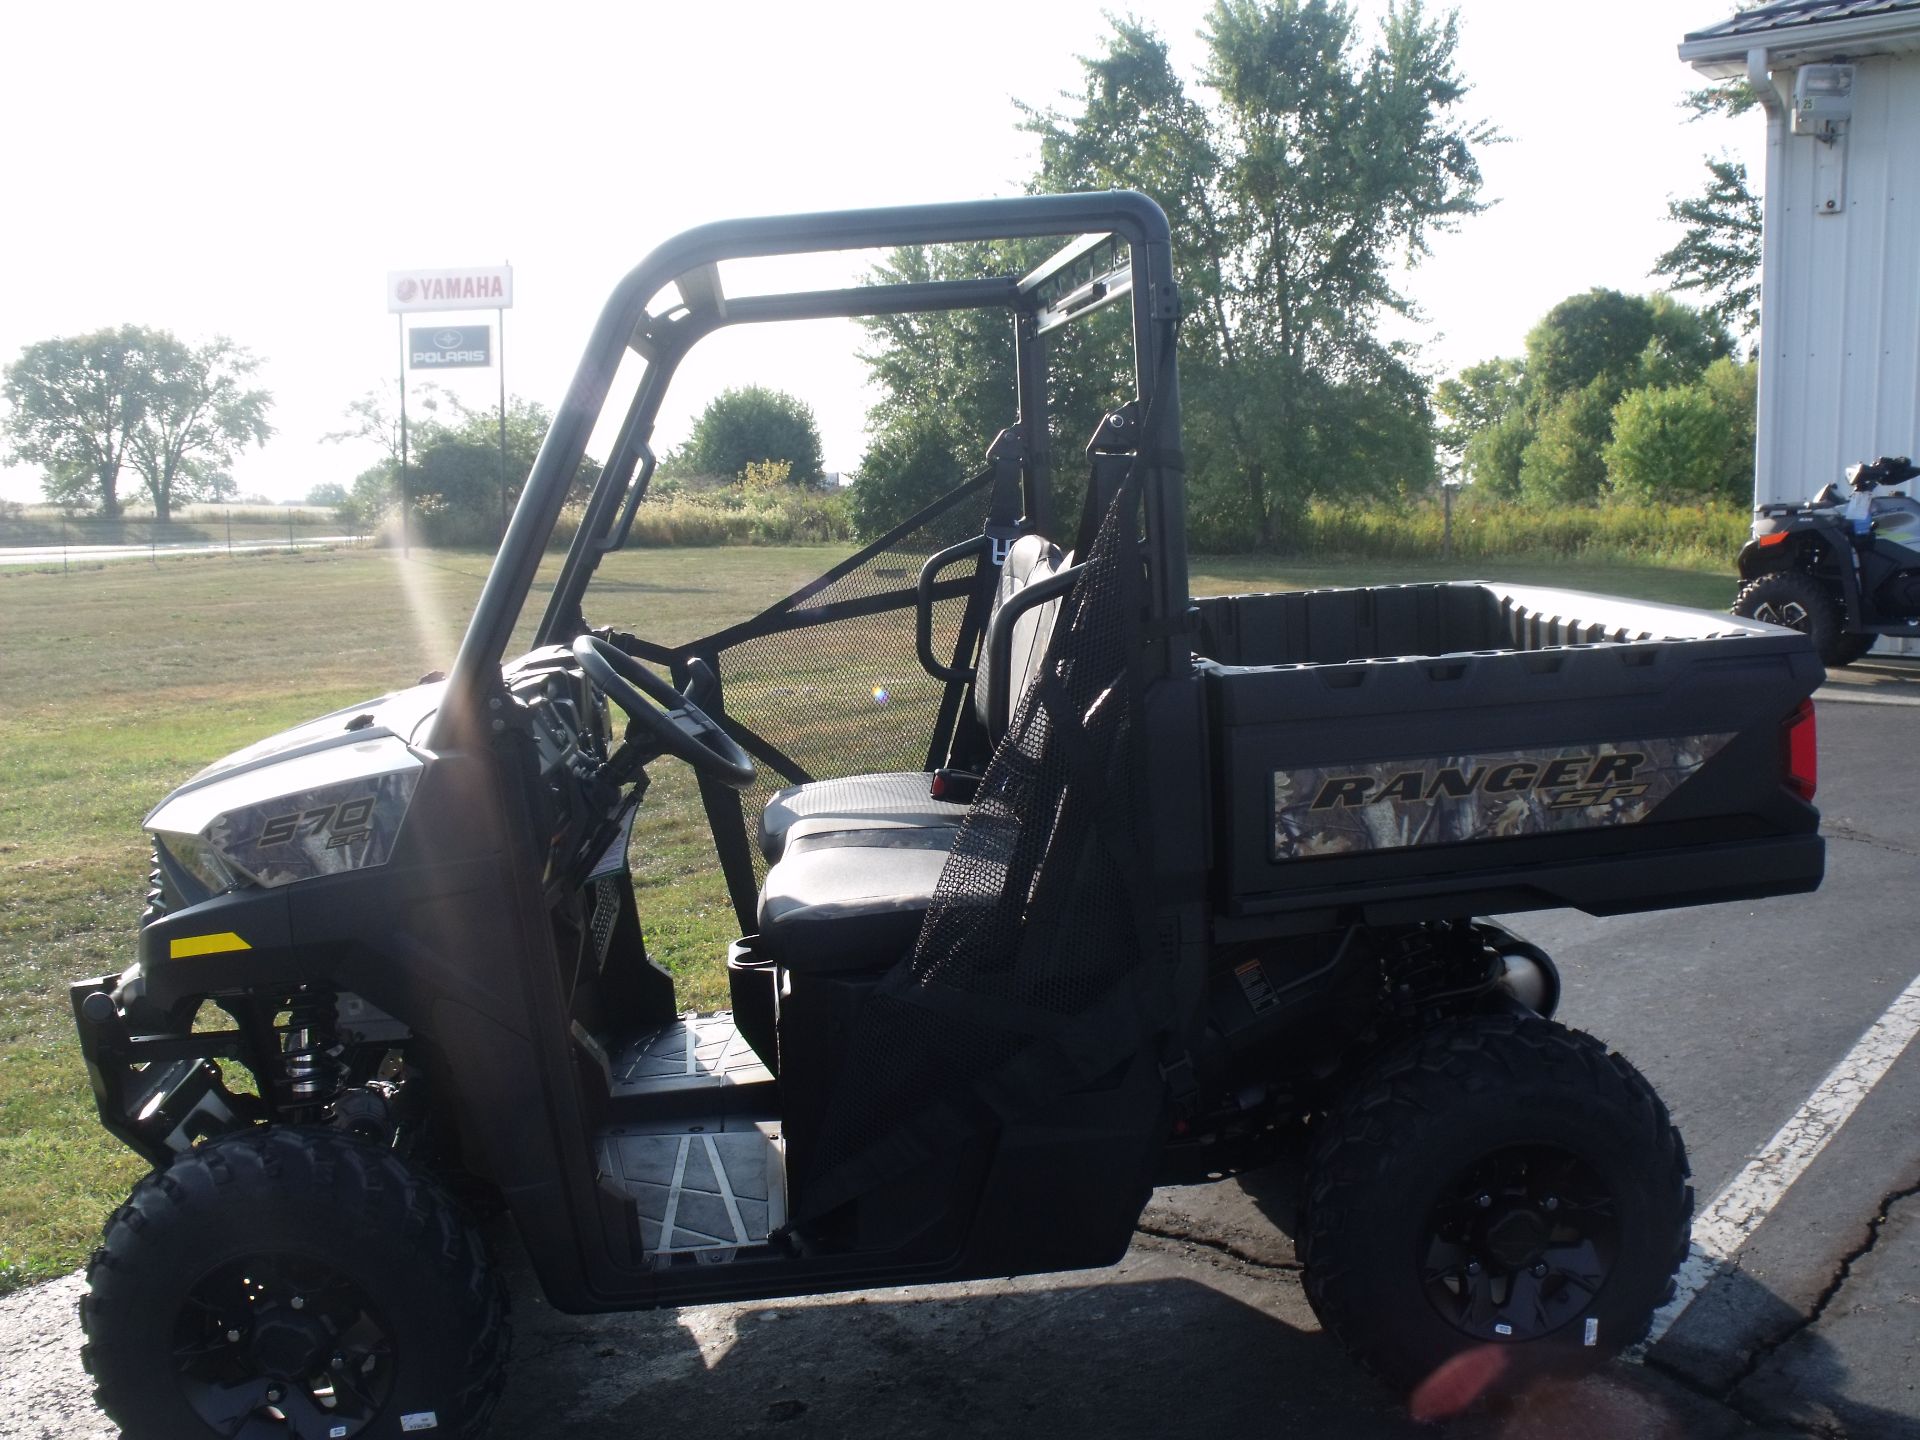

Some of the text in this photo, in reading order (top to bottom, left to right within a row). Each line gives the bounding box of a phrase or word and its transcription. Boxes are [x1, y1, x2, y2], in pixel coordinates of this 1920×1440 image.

[420, 276, 503, 300] YAMAHA
[413, 350, 485, 363] POLARIS
[1309, 752, 1646, 810] RANGER
[1549, 784, 1650, 810] SP
[257, 795, 377, 848] 570
[325, 828, 372, 849] EFI
